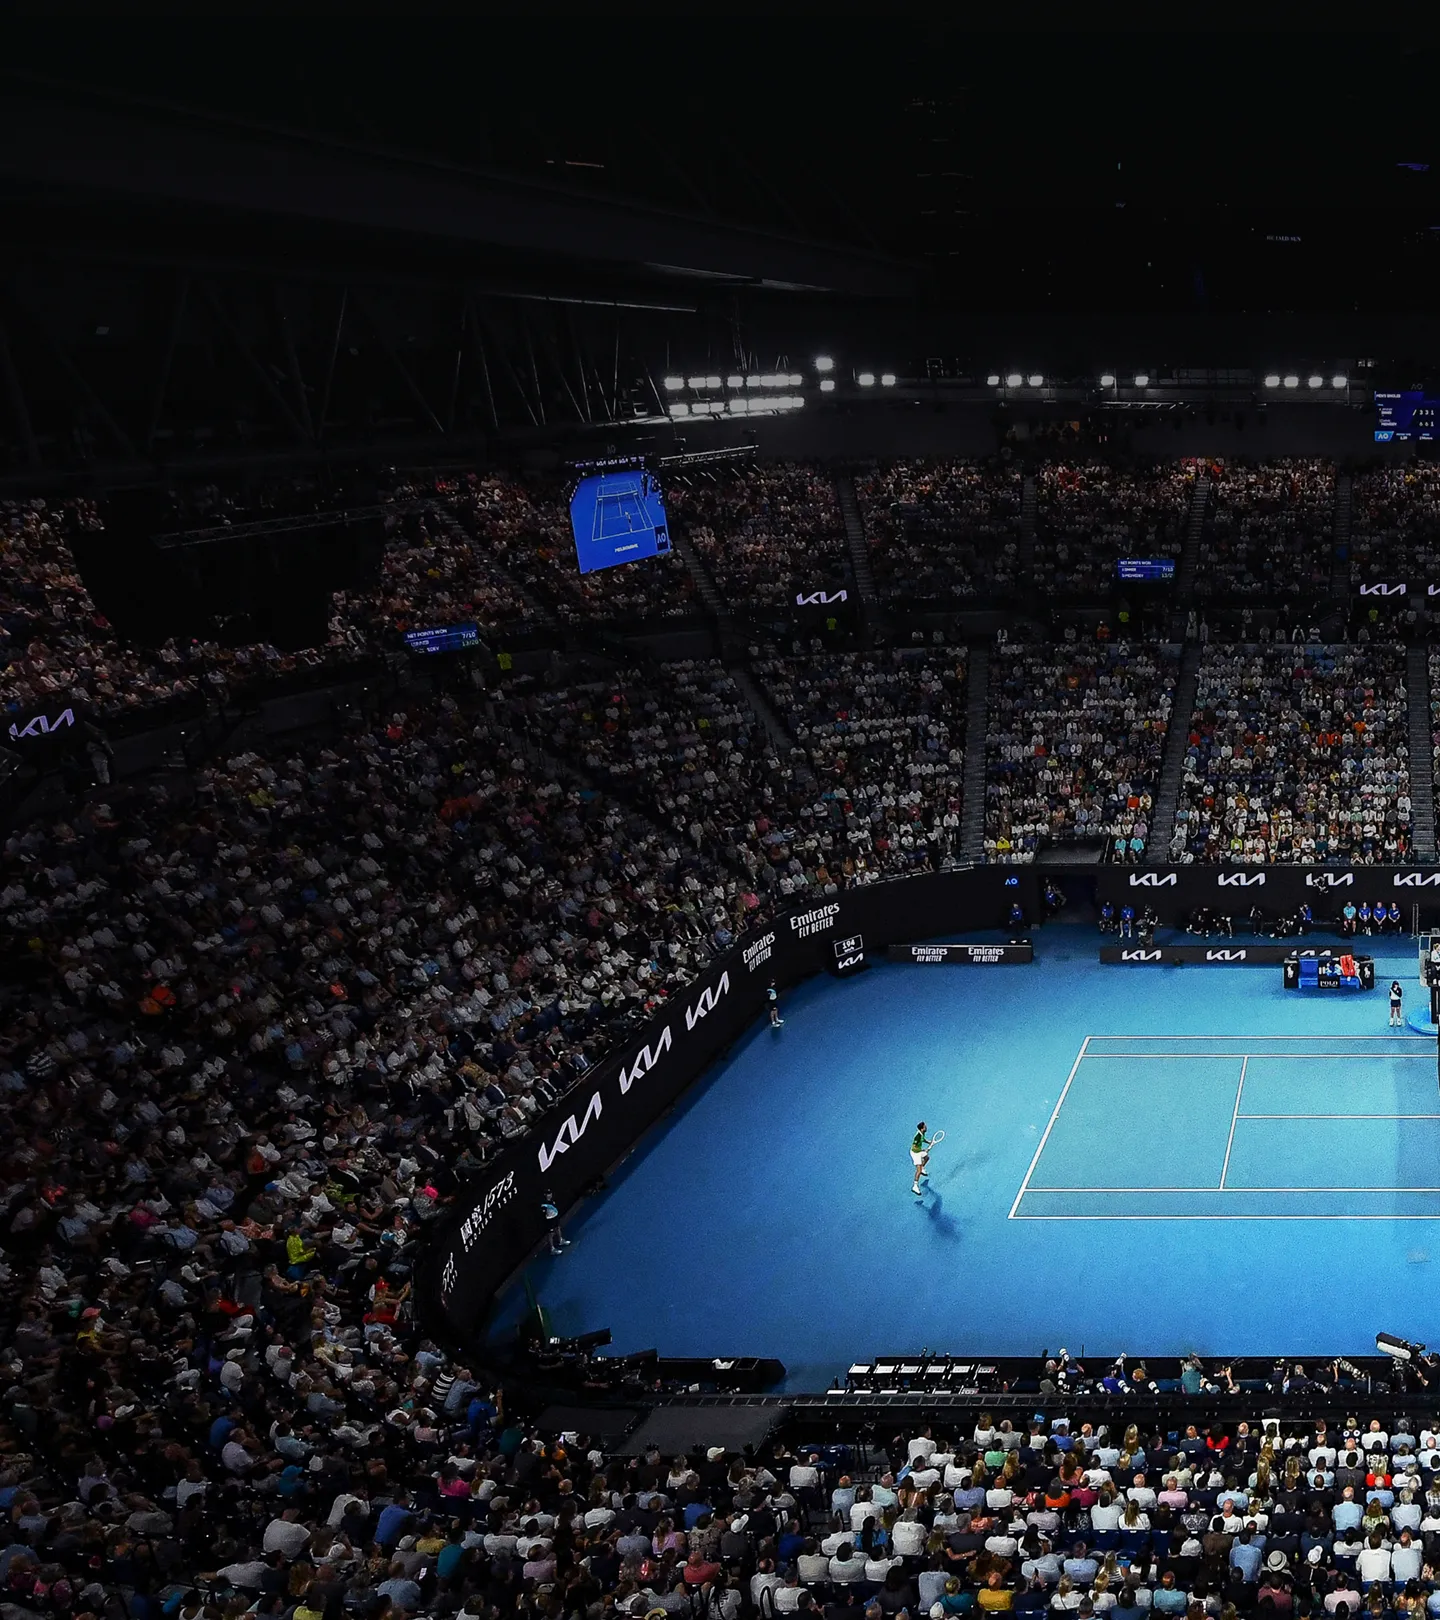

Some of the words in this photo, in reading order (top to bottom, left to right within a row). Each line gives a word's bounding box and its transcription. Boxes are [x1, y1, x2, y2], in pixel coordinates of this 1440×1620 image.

[1360, 584, 1405, 596] KIA
[794, 590, 847, 604] KIA
[9, 708, 75, 741] KIA
[1130, 873, 1177, 886] KIA
[1218, 873, 1265, 886] KIA
[1394, 873, 1440, 886] KIA
[790, 902, 840, 930] Emirates
[799, 923, 811, 938] FLY
[811, 916, 834, 934] BETTER
[742, 931, 776, 964] Emirates
[912, 947, 948, 955] Emirates
[968, 947, 1004, 955] Emirates
[1122, 950, 1161, 961] KIA
[1207, 950, 1246, 961] KIA
[686, 970, 730, 1031] KIA
[618, 1026, 672, 1095] KIA
[538, 1091, 603, 1173] KIA
